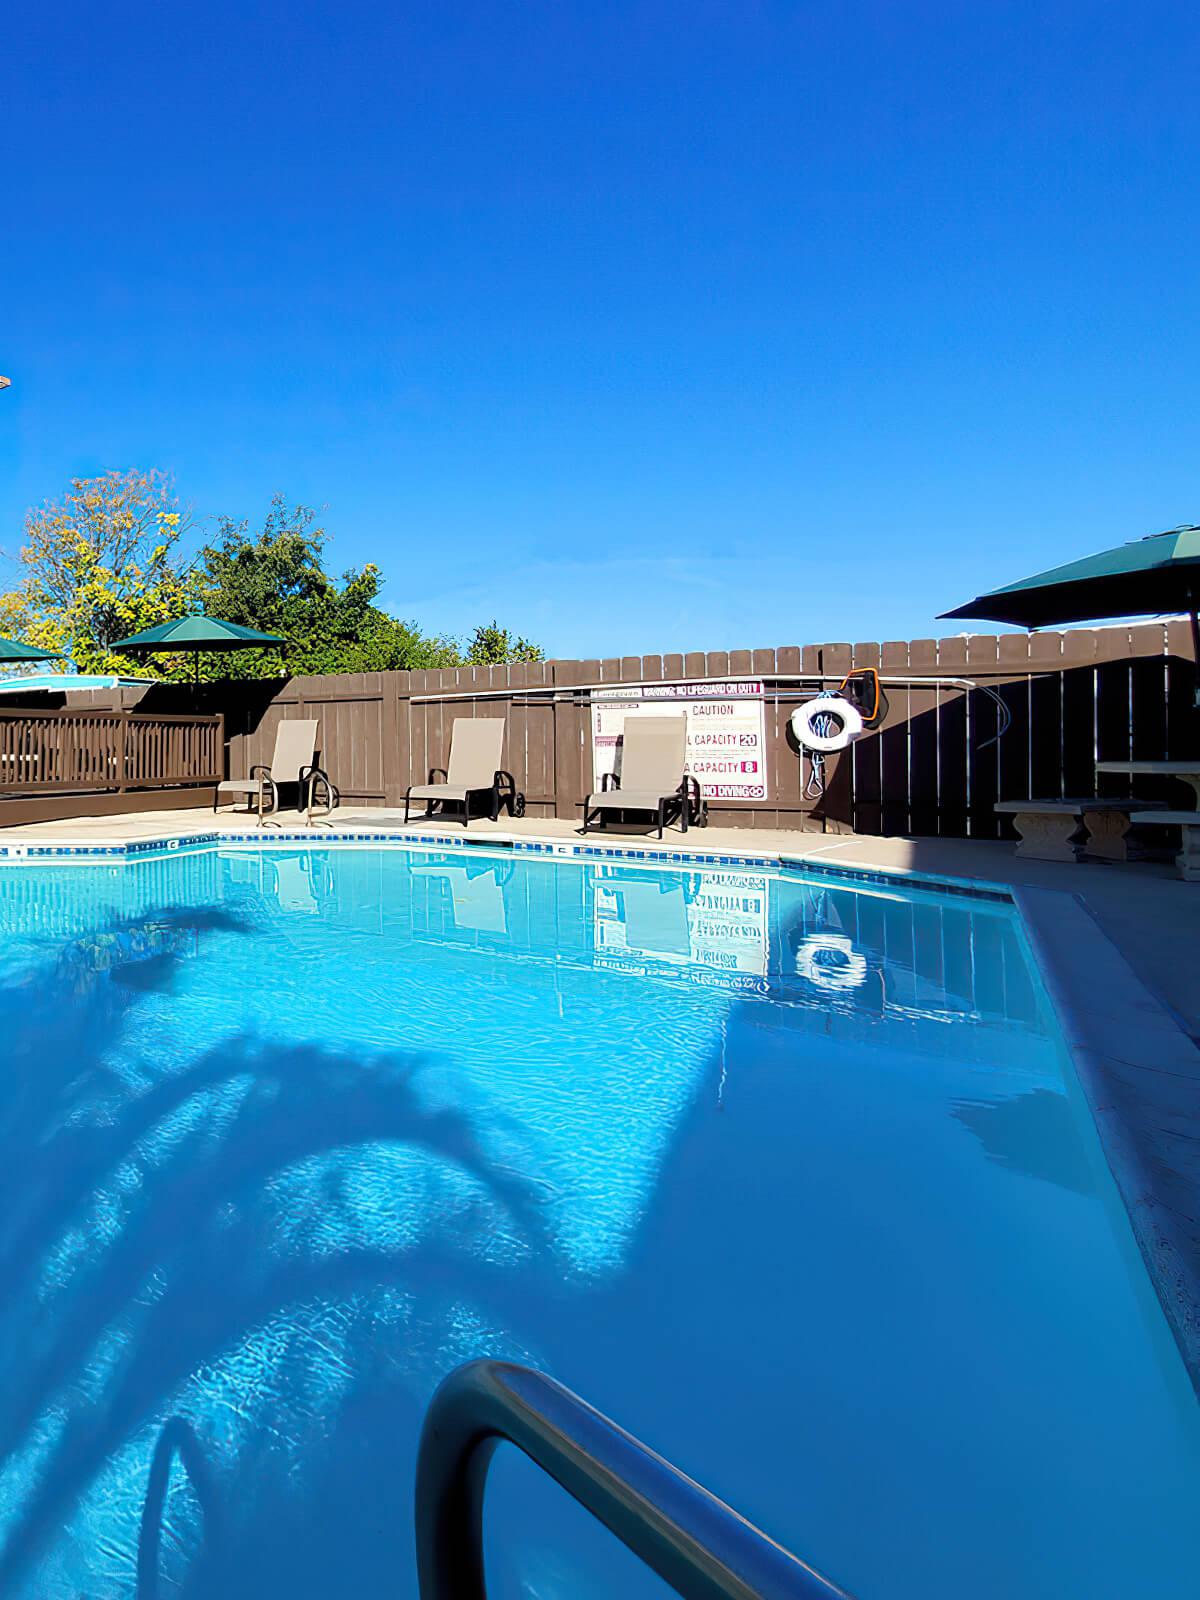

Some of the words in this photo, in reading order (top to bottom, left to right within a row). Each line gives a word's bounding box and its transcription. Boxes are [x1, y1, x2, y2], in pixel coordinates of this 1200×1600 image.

[738, 683, 757, 693] DUTY
[692, 704, 734, 716] CAUTION
[694, 734, 737, 745] CAPACITY
[740, 735, 756, 746] 20
[693, 762, 738, 773] CAPACITY
[703, 785, 716, 797] NO
[717, 785, 749, 797] DIVING
